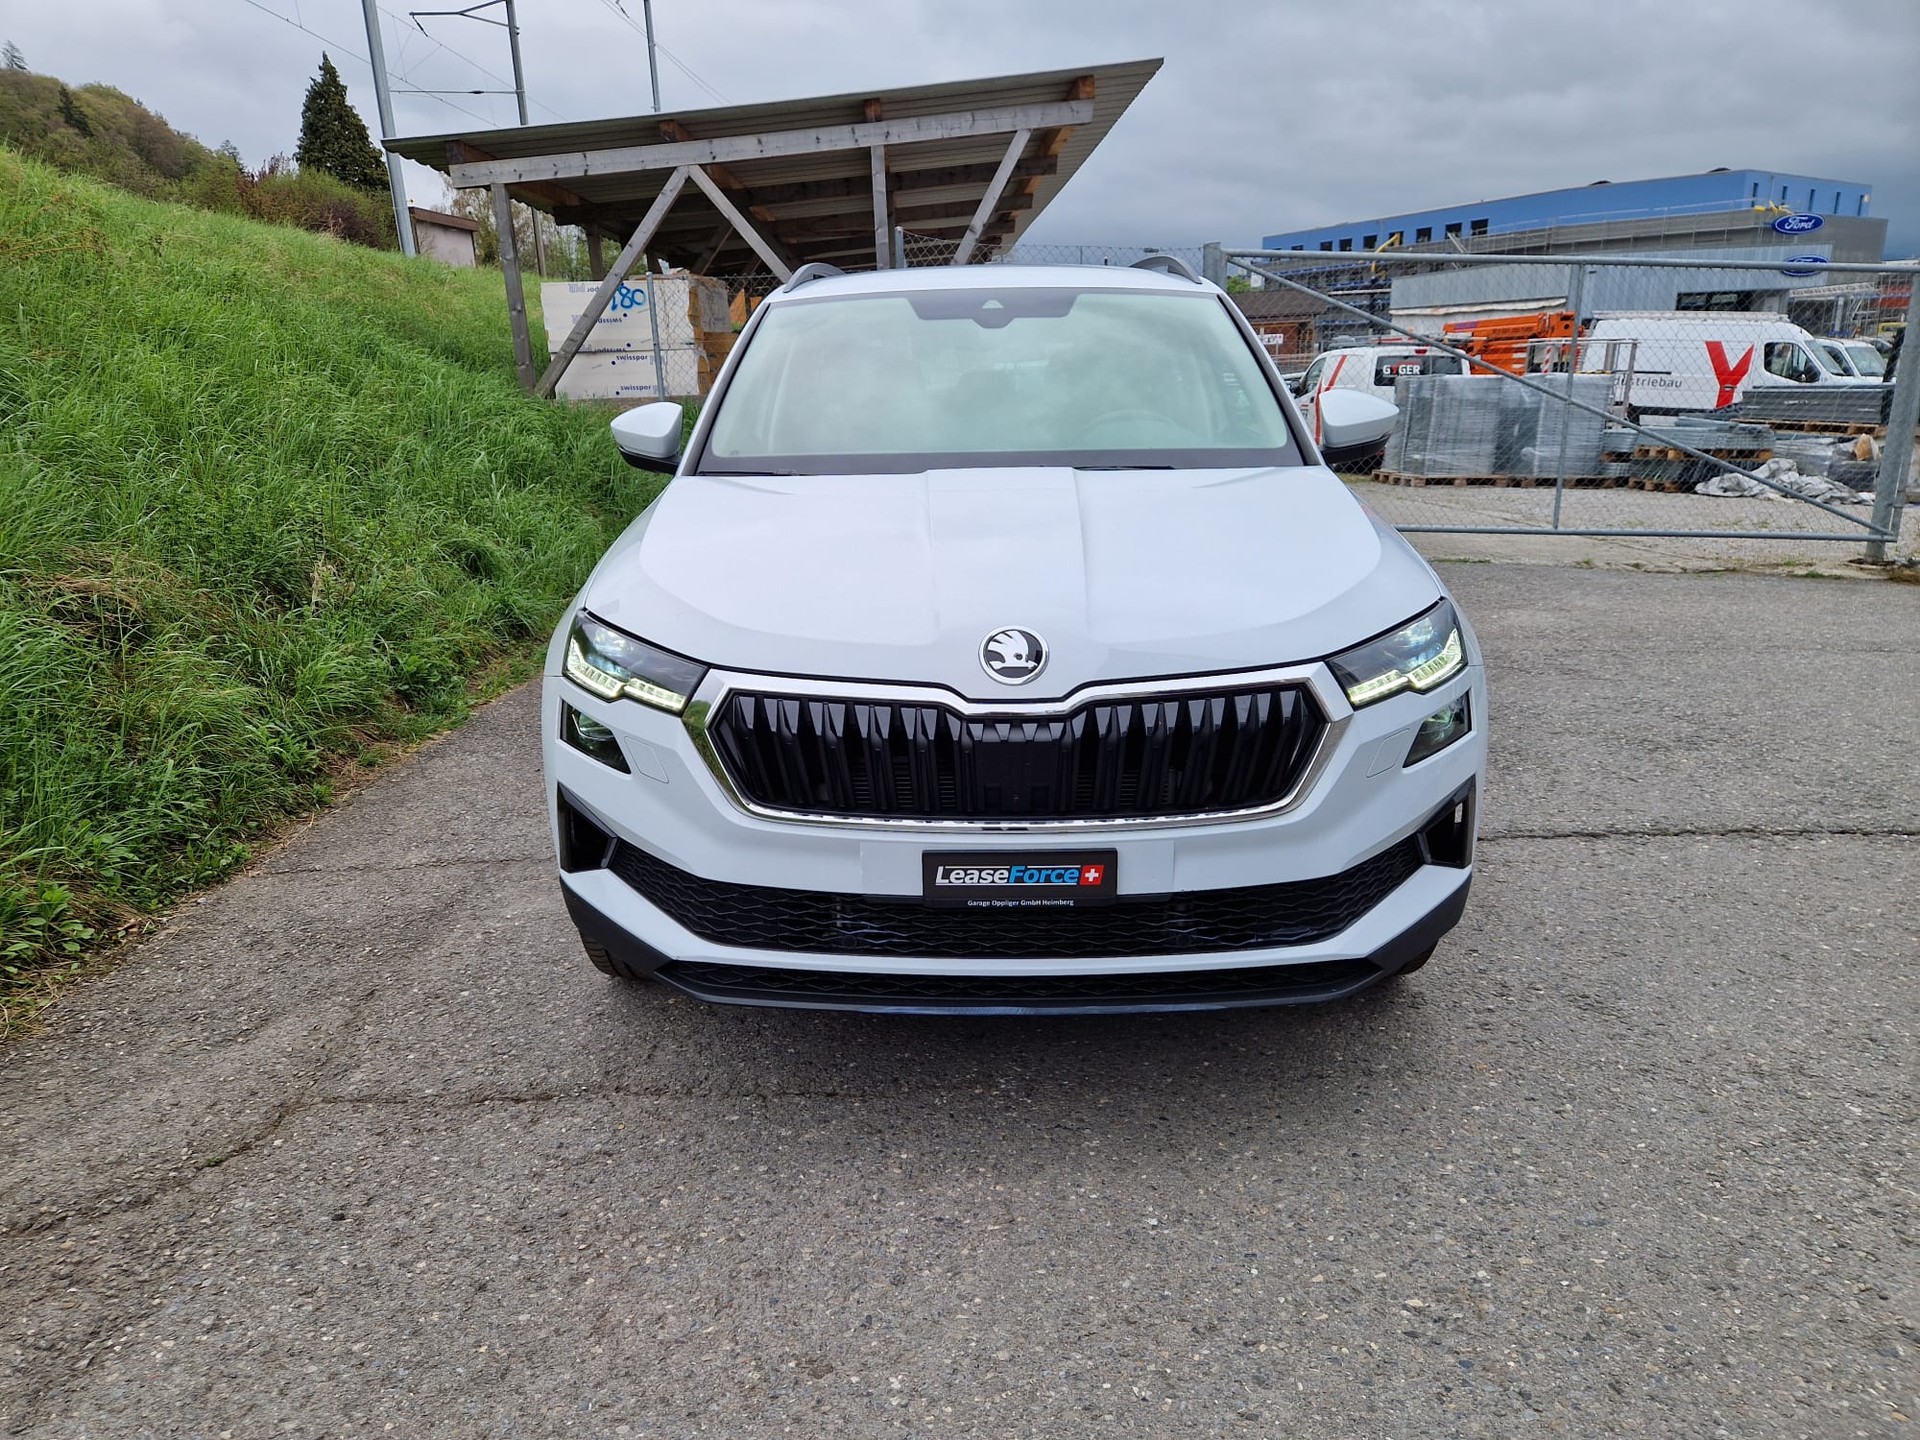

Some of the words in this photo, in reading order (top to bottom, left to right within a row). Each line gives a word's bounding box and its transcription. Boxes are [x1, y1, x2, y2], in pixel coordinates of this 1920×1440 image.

[1784, 216, 1815, 230] Ford
[616, 354, 648, 362] swisspor
[935, 865, 1080, 885] LeaseForce
[967, 899, 990, 907] Garage
[991, 899, 1019, 907] Oppliger
[1020, 898, 1041, 906] GmbH
[1042, 898, 1074, 906] Heimberg
